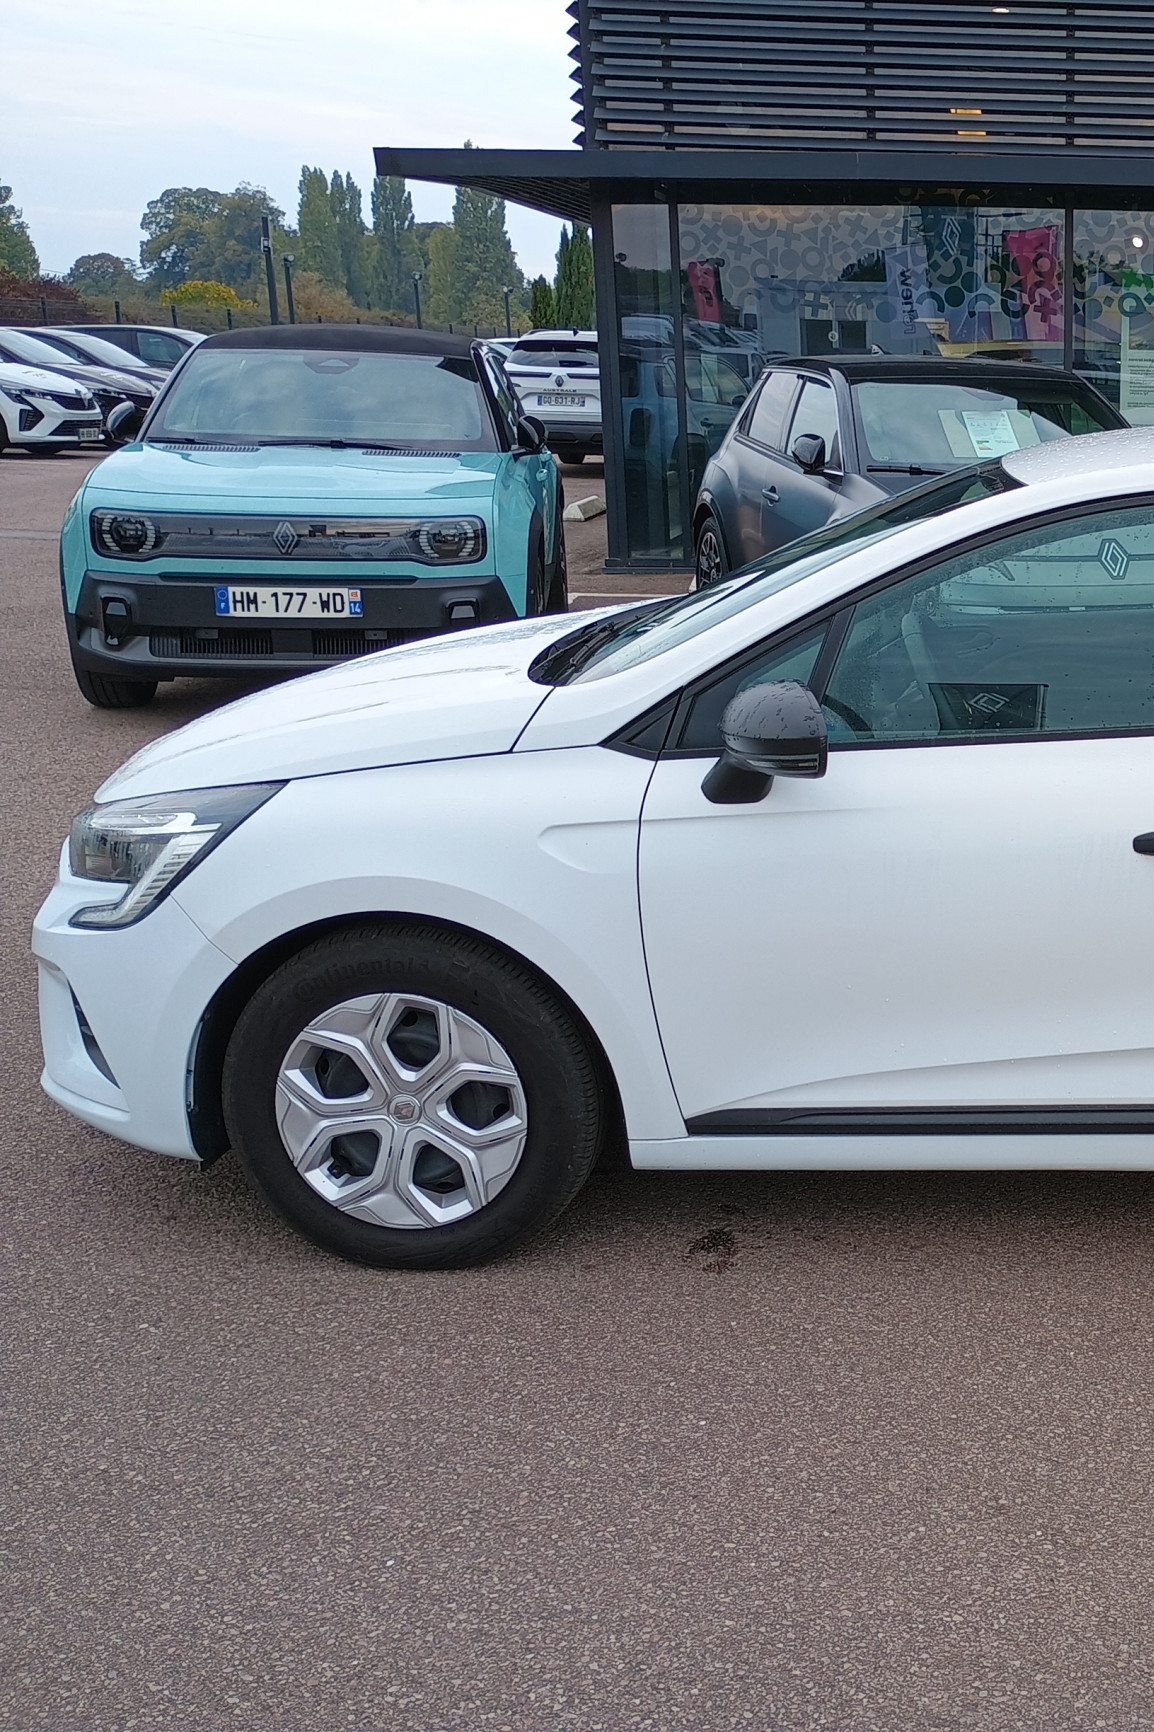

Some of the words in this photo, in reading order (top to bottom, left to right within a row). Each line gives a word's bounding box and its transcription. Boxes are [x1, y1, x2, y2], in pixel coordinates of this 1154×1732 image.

[220, 602, 226, 610] F
[232, 591, 345, 613] HM-177-WD
[350, 603, 361, 614] 14
